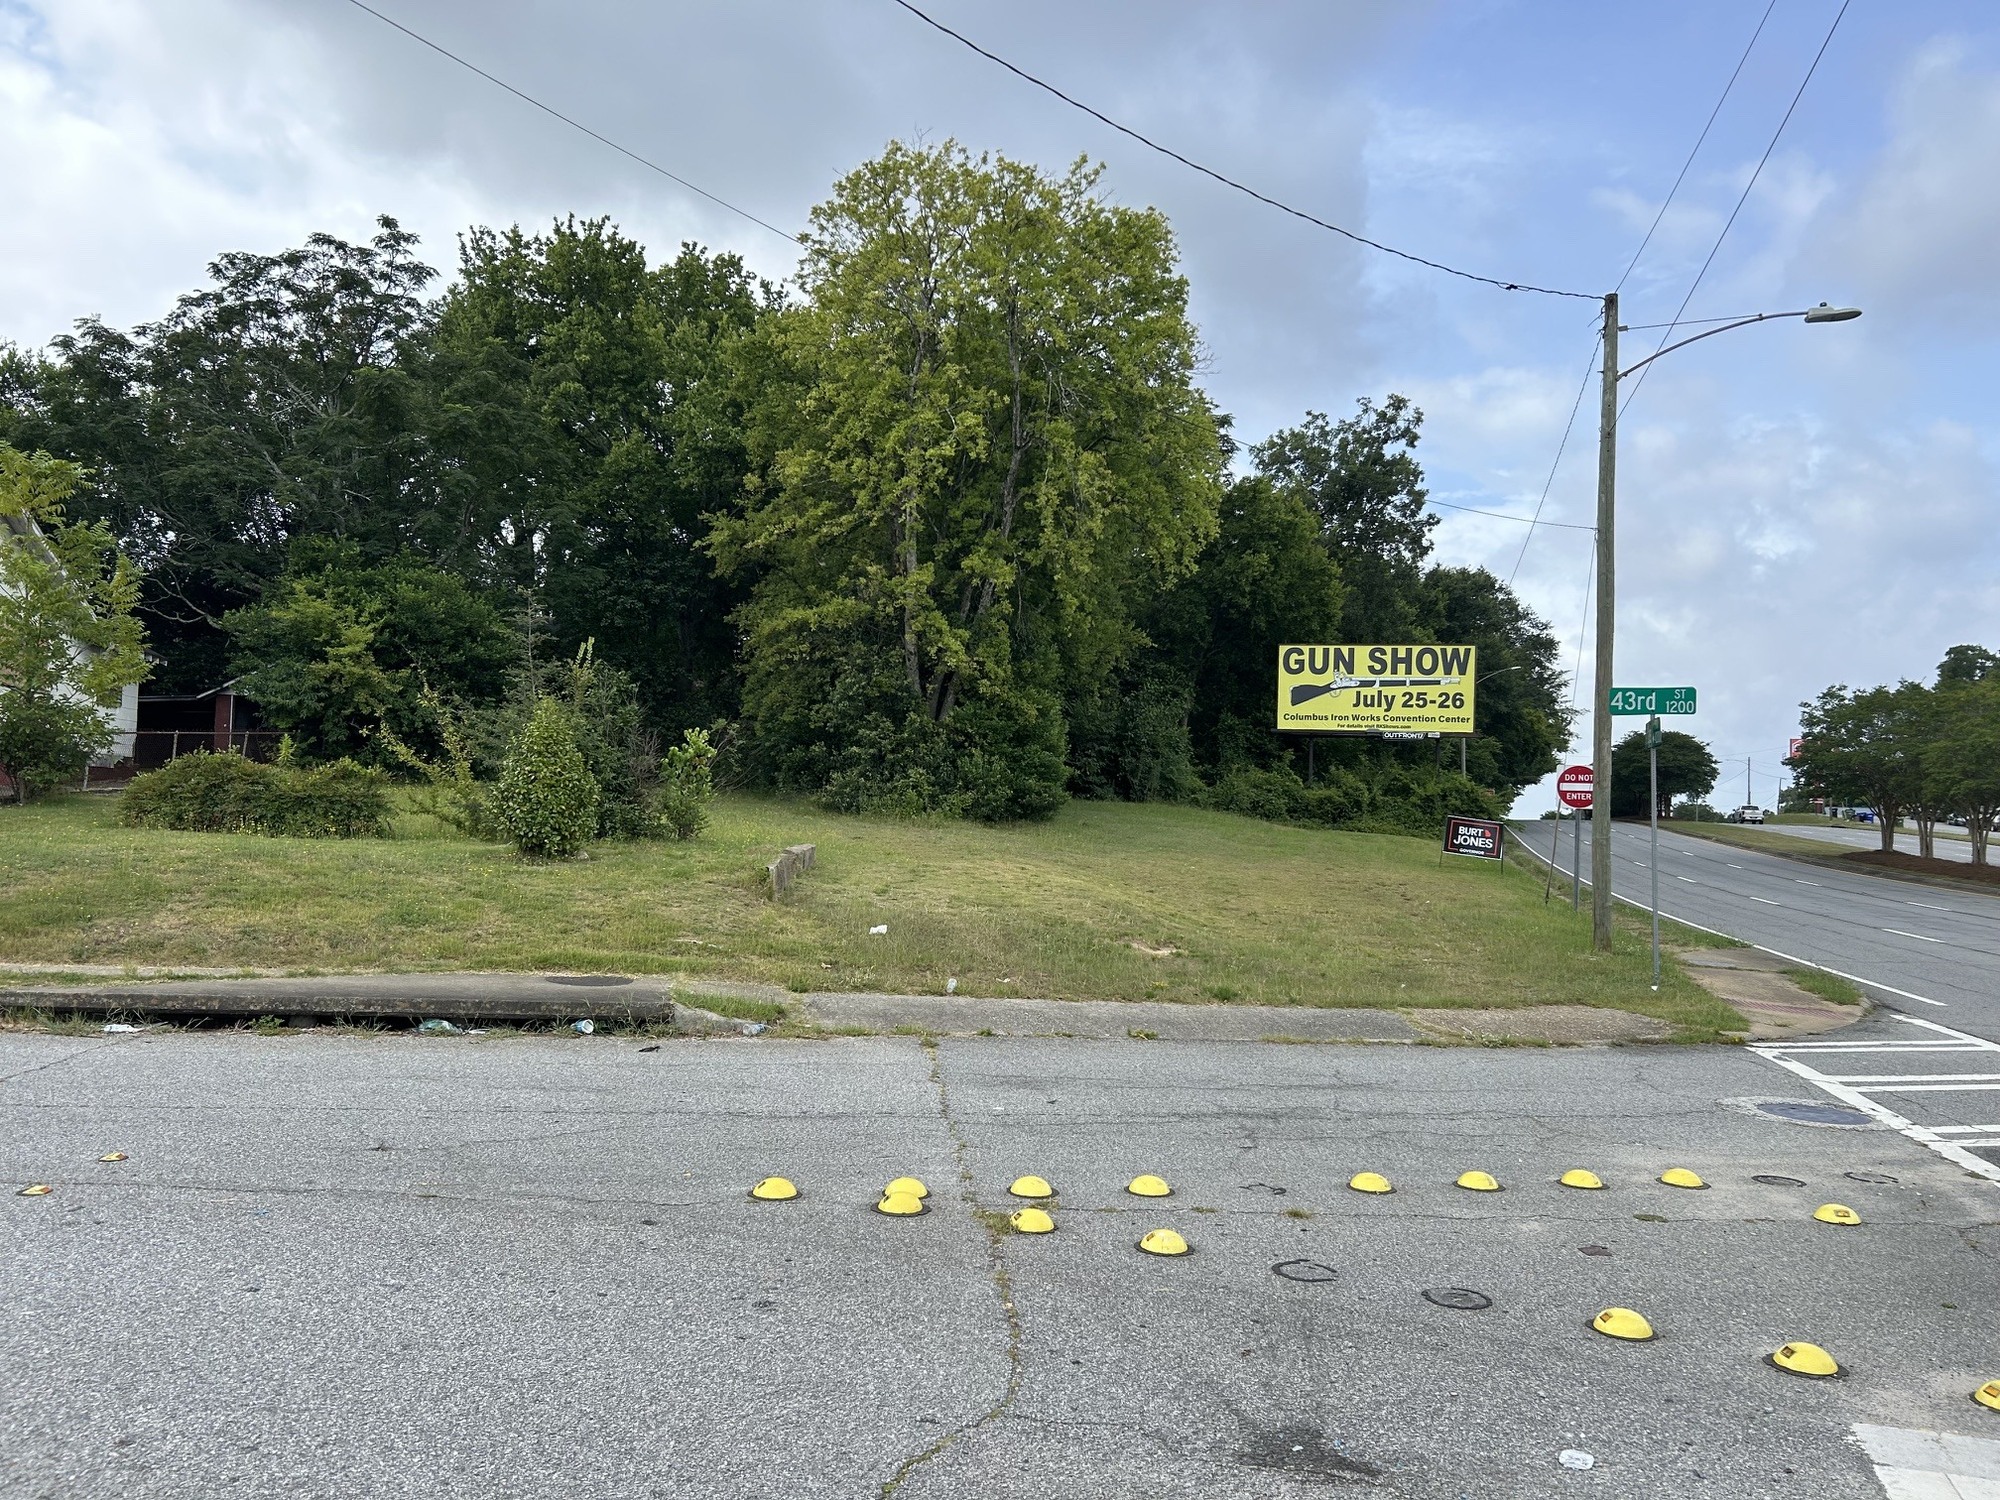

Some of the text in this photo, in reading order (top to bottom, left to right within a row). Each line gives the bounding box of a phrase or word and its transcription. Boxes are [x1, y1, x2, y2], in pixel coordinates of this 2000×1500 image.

[1282, 647, 1471, 676] GUN SHOW
[1352, 690, 1465, 712] July 25-26
[1610, 689, 1686, 711] 43rd ST
[1665, 700, 1695, 713] 1200
[1283, 713, 1470, 723] Columbus Iron Works Convention Center
[1458, 826, 1484, 836] BURT
[1453, 835, 1493, 848] JONES
